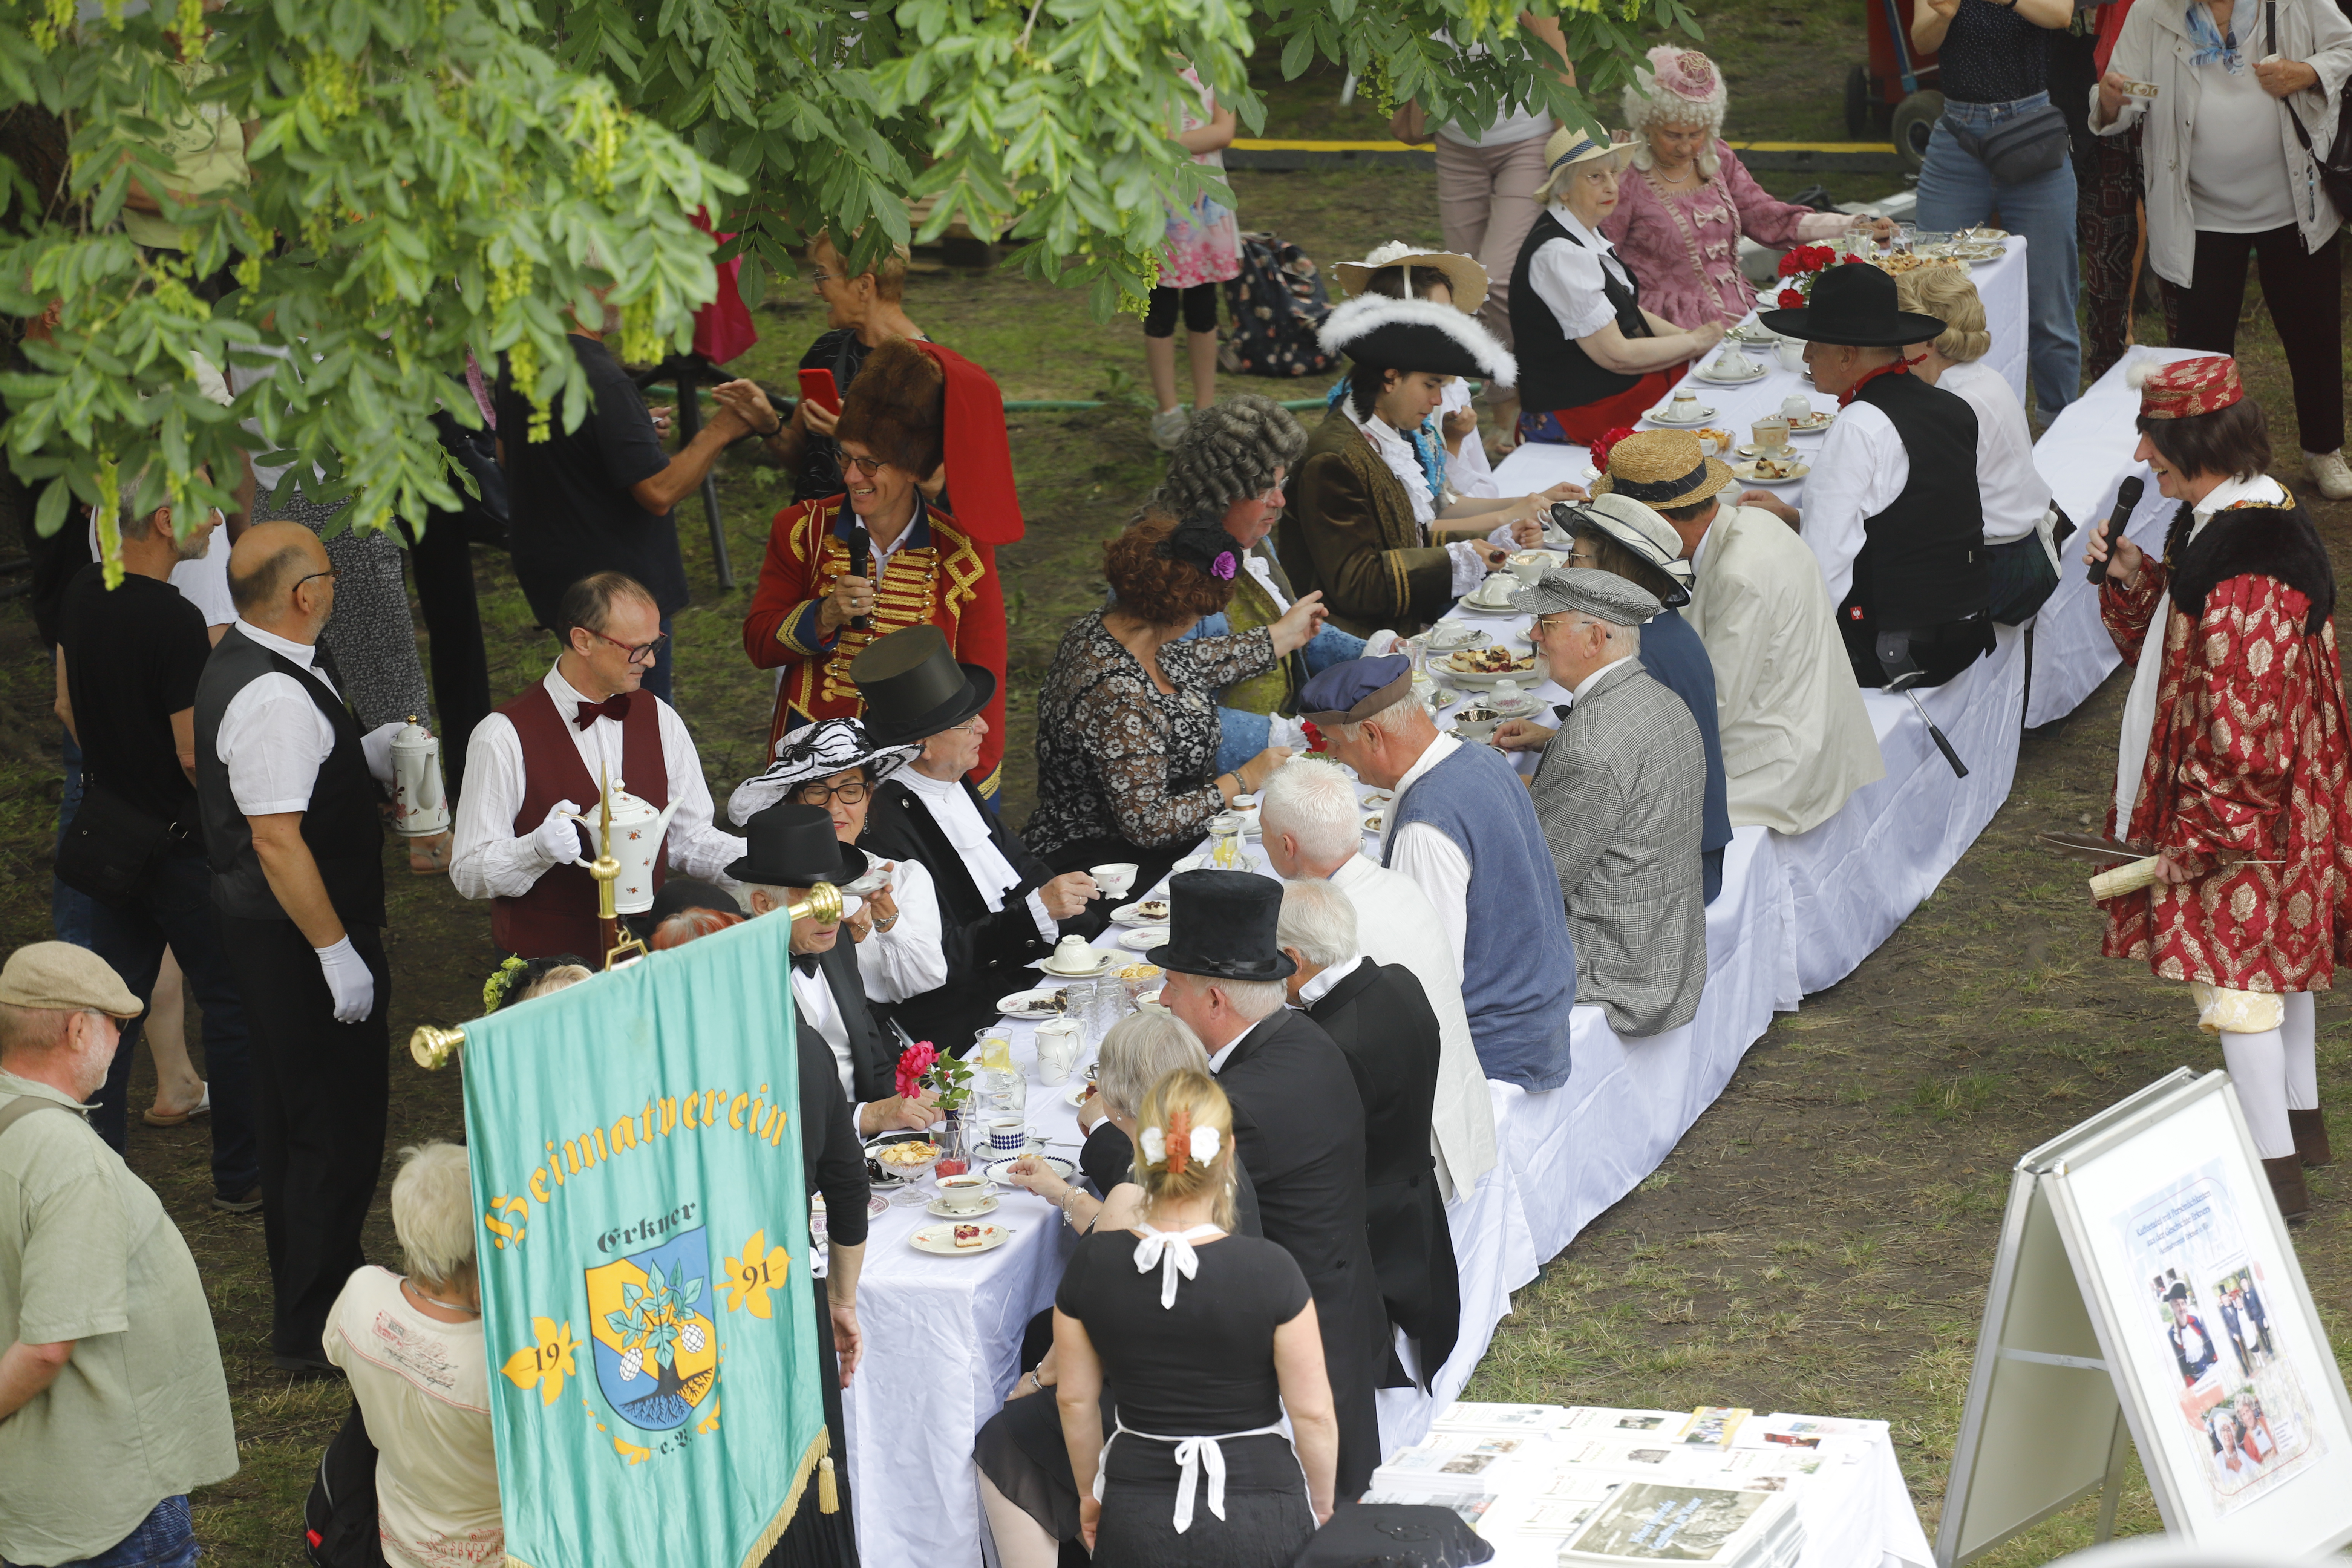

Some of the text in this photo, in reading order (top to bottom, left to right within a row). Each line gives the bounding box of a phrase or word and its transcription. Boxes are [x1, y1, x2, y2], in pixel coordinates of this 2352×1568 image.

[485, 1084, 788, 1250] Heimatverein
[597, 1200, 696, 1253] Erkner
[2135, 1190, 2211, 1237] Kaffeetafel mit Persönlichkeiten
[2156, 1232, 2165, 1242] der
[2165, 1216, 2191, 1236] Geschichte
[2191, 1205, 2211, 1221] Erkners
[742, 1261, 772, 1292] 91
[534, 1343, 560, 1372] 19
